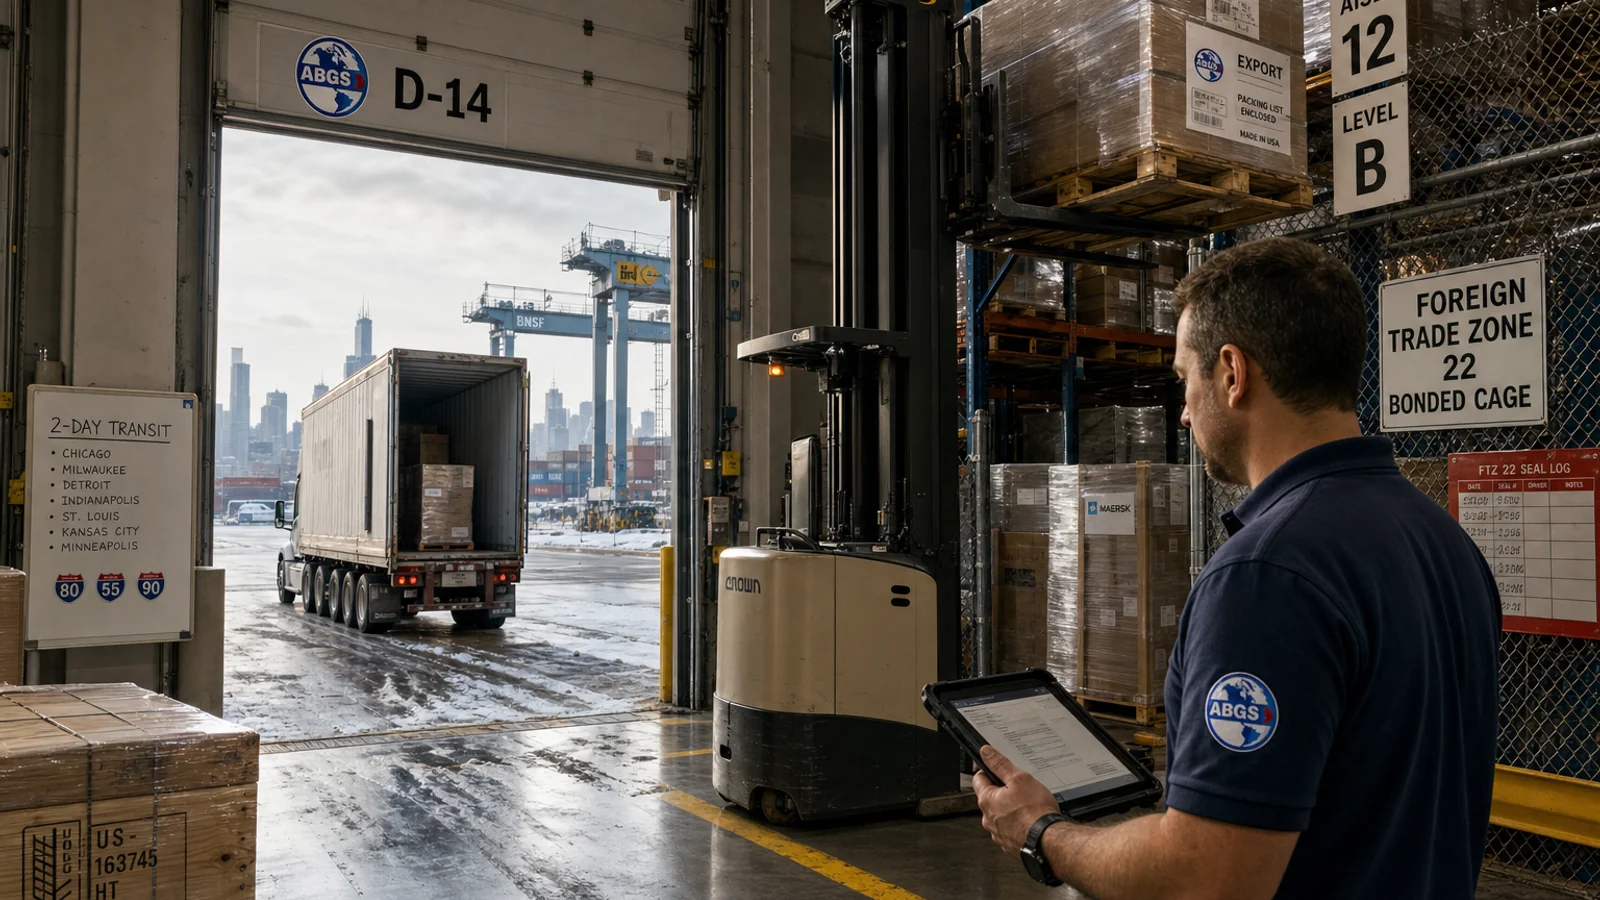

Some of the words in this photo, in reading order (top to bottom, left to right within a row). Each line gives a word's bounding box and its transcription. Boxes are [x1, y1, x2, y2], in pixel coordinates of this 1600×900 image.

[1342, 14, 1395, 76] 12
[300, 65, 351, 87] ABGS
[1237, 54, 1283, 80] EXPORT
[395, 67, 492, 123] D-14
[1237, 94, 1268, 110] PACKING
[1270, 104, 1284, 114] LIST
[1240, 107, 1277, 124] ENCLOSED
[1343, 102, 1398, 134] LEVEL
[1240, 129, 1258, 141] MADE
[1259, 135, 1266, 143] IN
[1266, 137, 1280, 148] USA
[1355, 138, 1387, 196] B
[1417, 277, 1526, 318] FOREIGN
[516, 315, 545, 328] BNSF
[1388, 321, 1460, 353] TRADE
[1468, 311, 1533, 344] ZONE
[1443, 352, 1477, 381] 22
[1389, 389, 1466, 415] BONDED
[1474, 384, 1531, 410] CAGE
[50, 417, 102, 435] 2-DAY
[108, 420, 172, 438] TRANSIT
[62, 449, 111, 459] CHICAGO
[62, 465, 126, 475] MILWAUKEE
[1478, 465, 1498, 476] FTZ
[1502, 464, 1516, 475] 22
[1520, 463, 1546, 475] SEAL
[1549, 463, 1571, 474] LOG
[63, 480, 111, 490] DETROIT
[61, 495, 140, 506] INDIANAPOLIS
[1099, 504, 1131, 513] MAERSK
[62, 511, 81, 521] ST.
[87, 511, 120, 521] LOUIS
[62, 527, 108, 537] KANSAS
[115, 526, 139, 536] CITY
[61, 541, 138, 552] MINNEAPOLIS
[60, 583, 80, 597] 80
[102, 582, 120, 597] 55
[142, 581, 160, 595] 90
[1209, 701, 1259, 721] ABGS
[95, 850, 158, 876] 163745
[95, 881, 119, 900] HT
